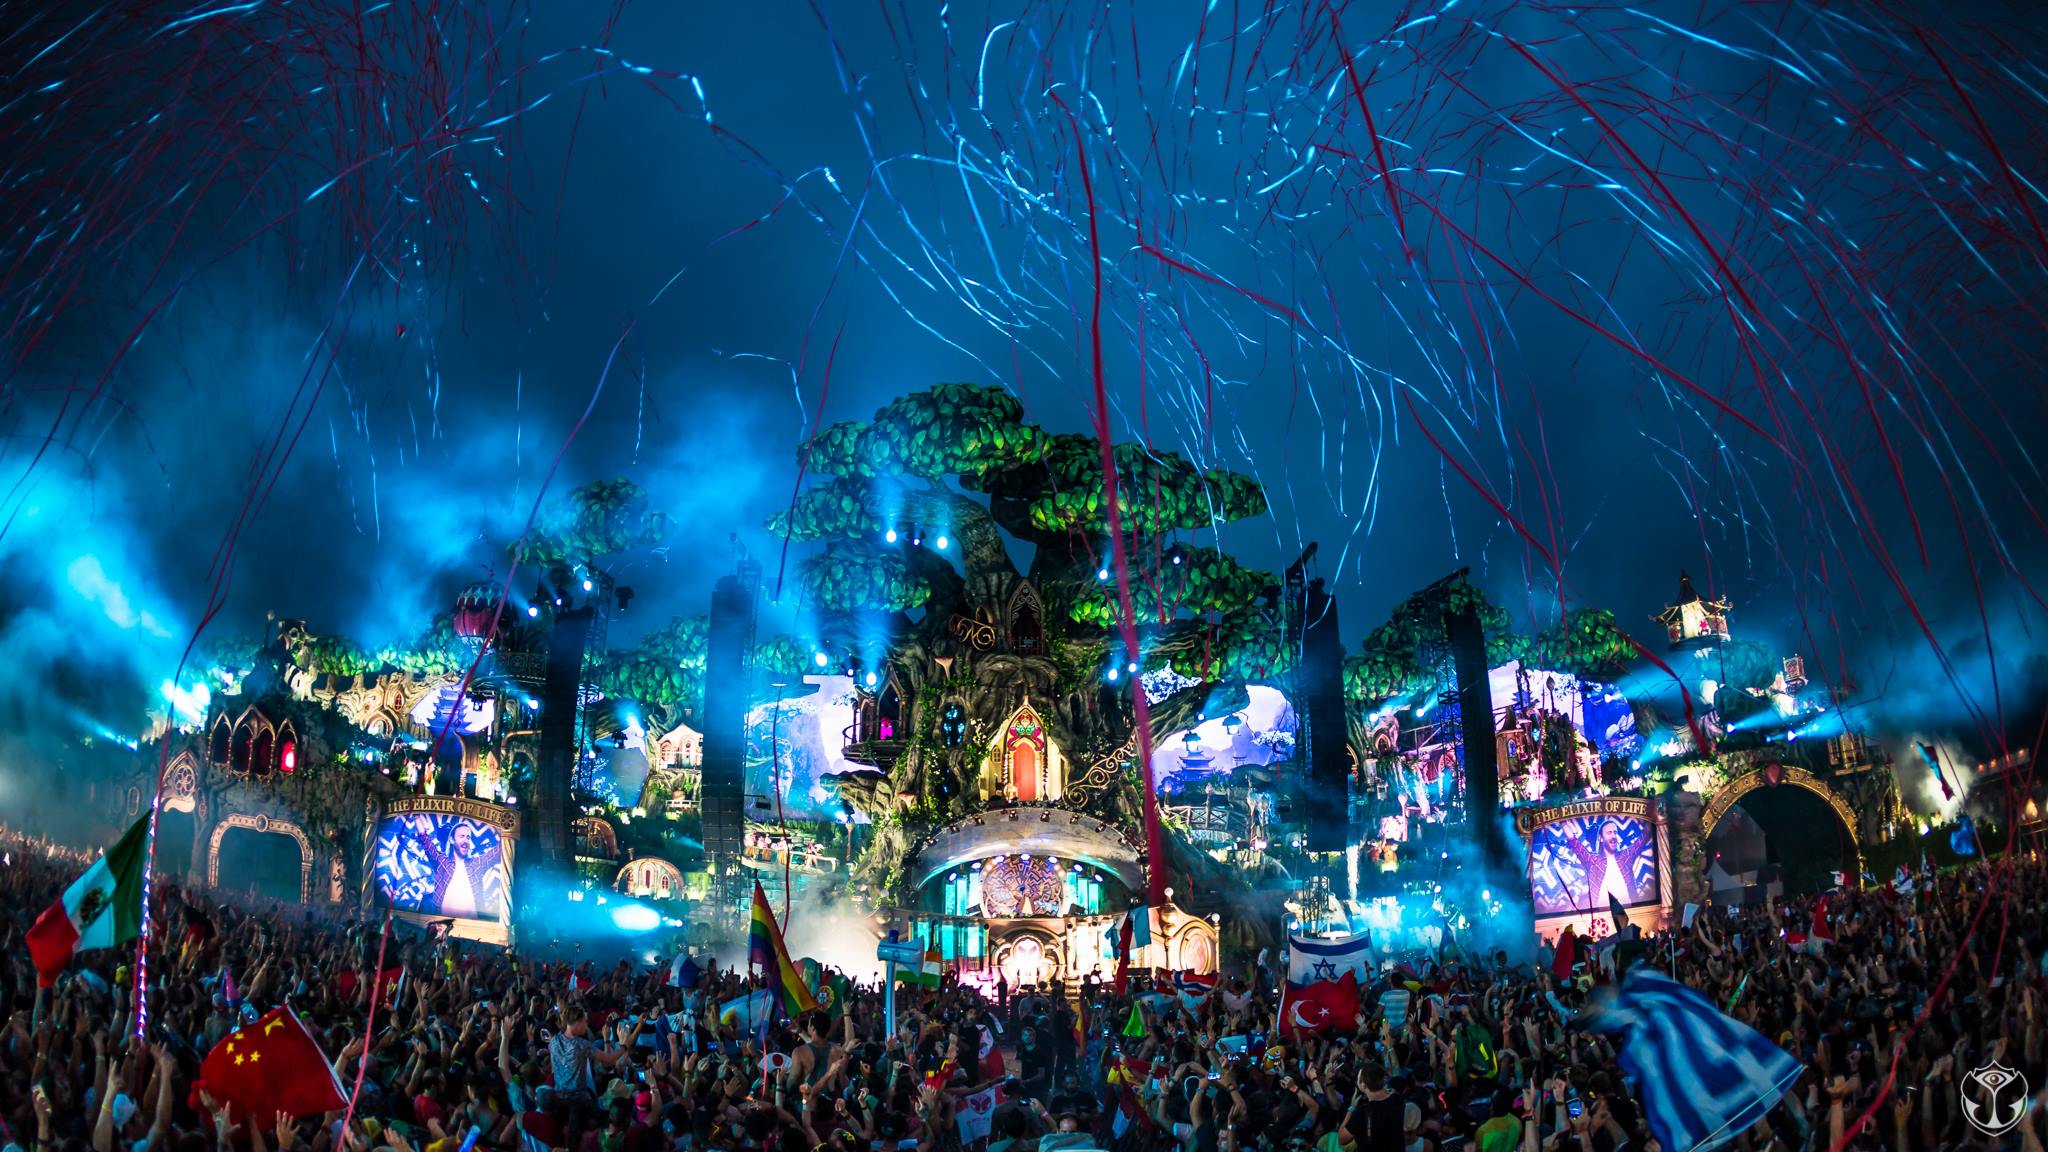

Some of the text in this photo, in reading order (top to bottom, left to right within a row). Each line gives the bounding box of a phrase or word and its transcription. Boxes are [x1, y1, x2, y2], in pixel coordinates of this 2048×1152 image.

[413, 799, 454, 812] ELIXIR
[457, 802, 473, 814] OF
[1534, 800, 1647, 824] THE ELIXIR OF LIFE
